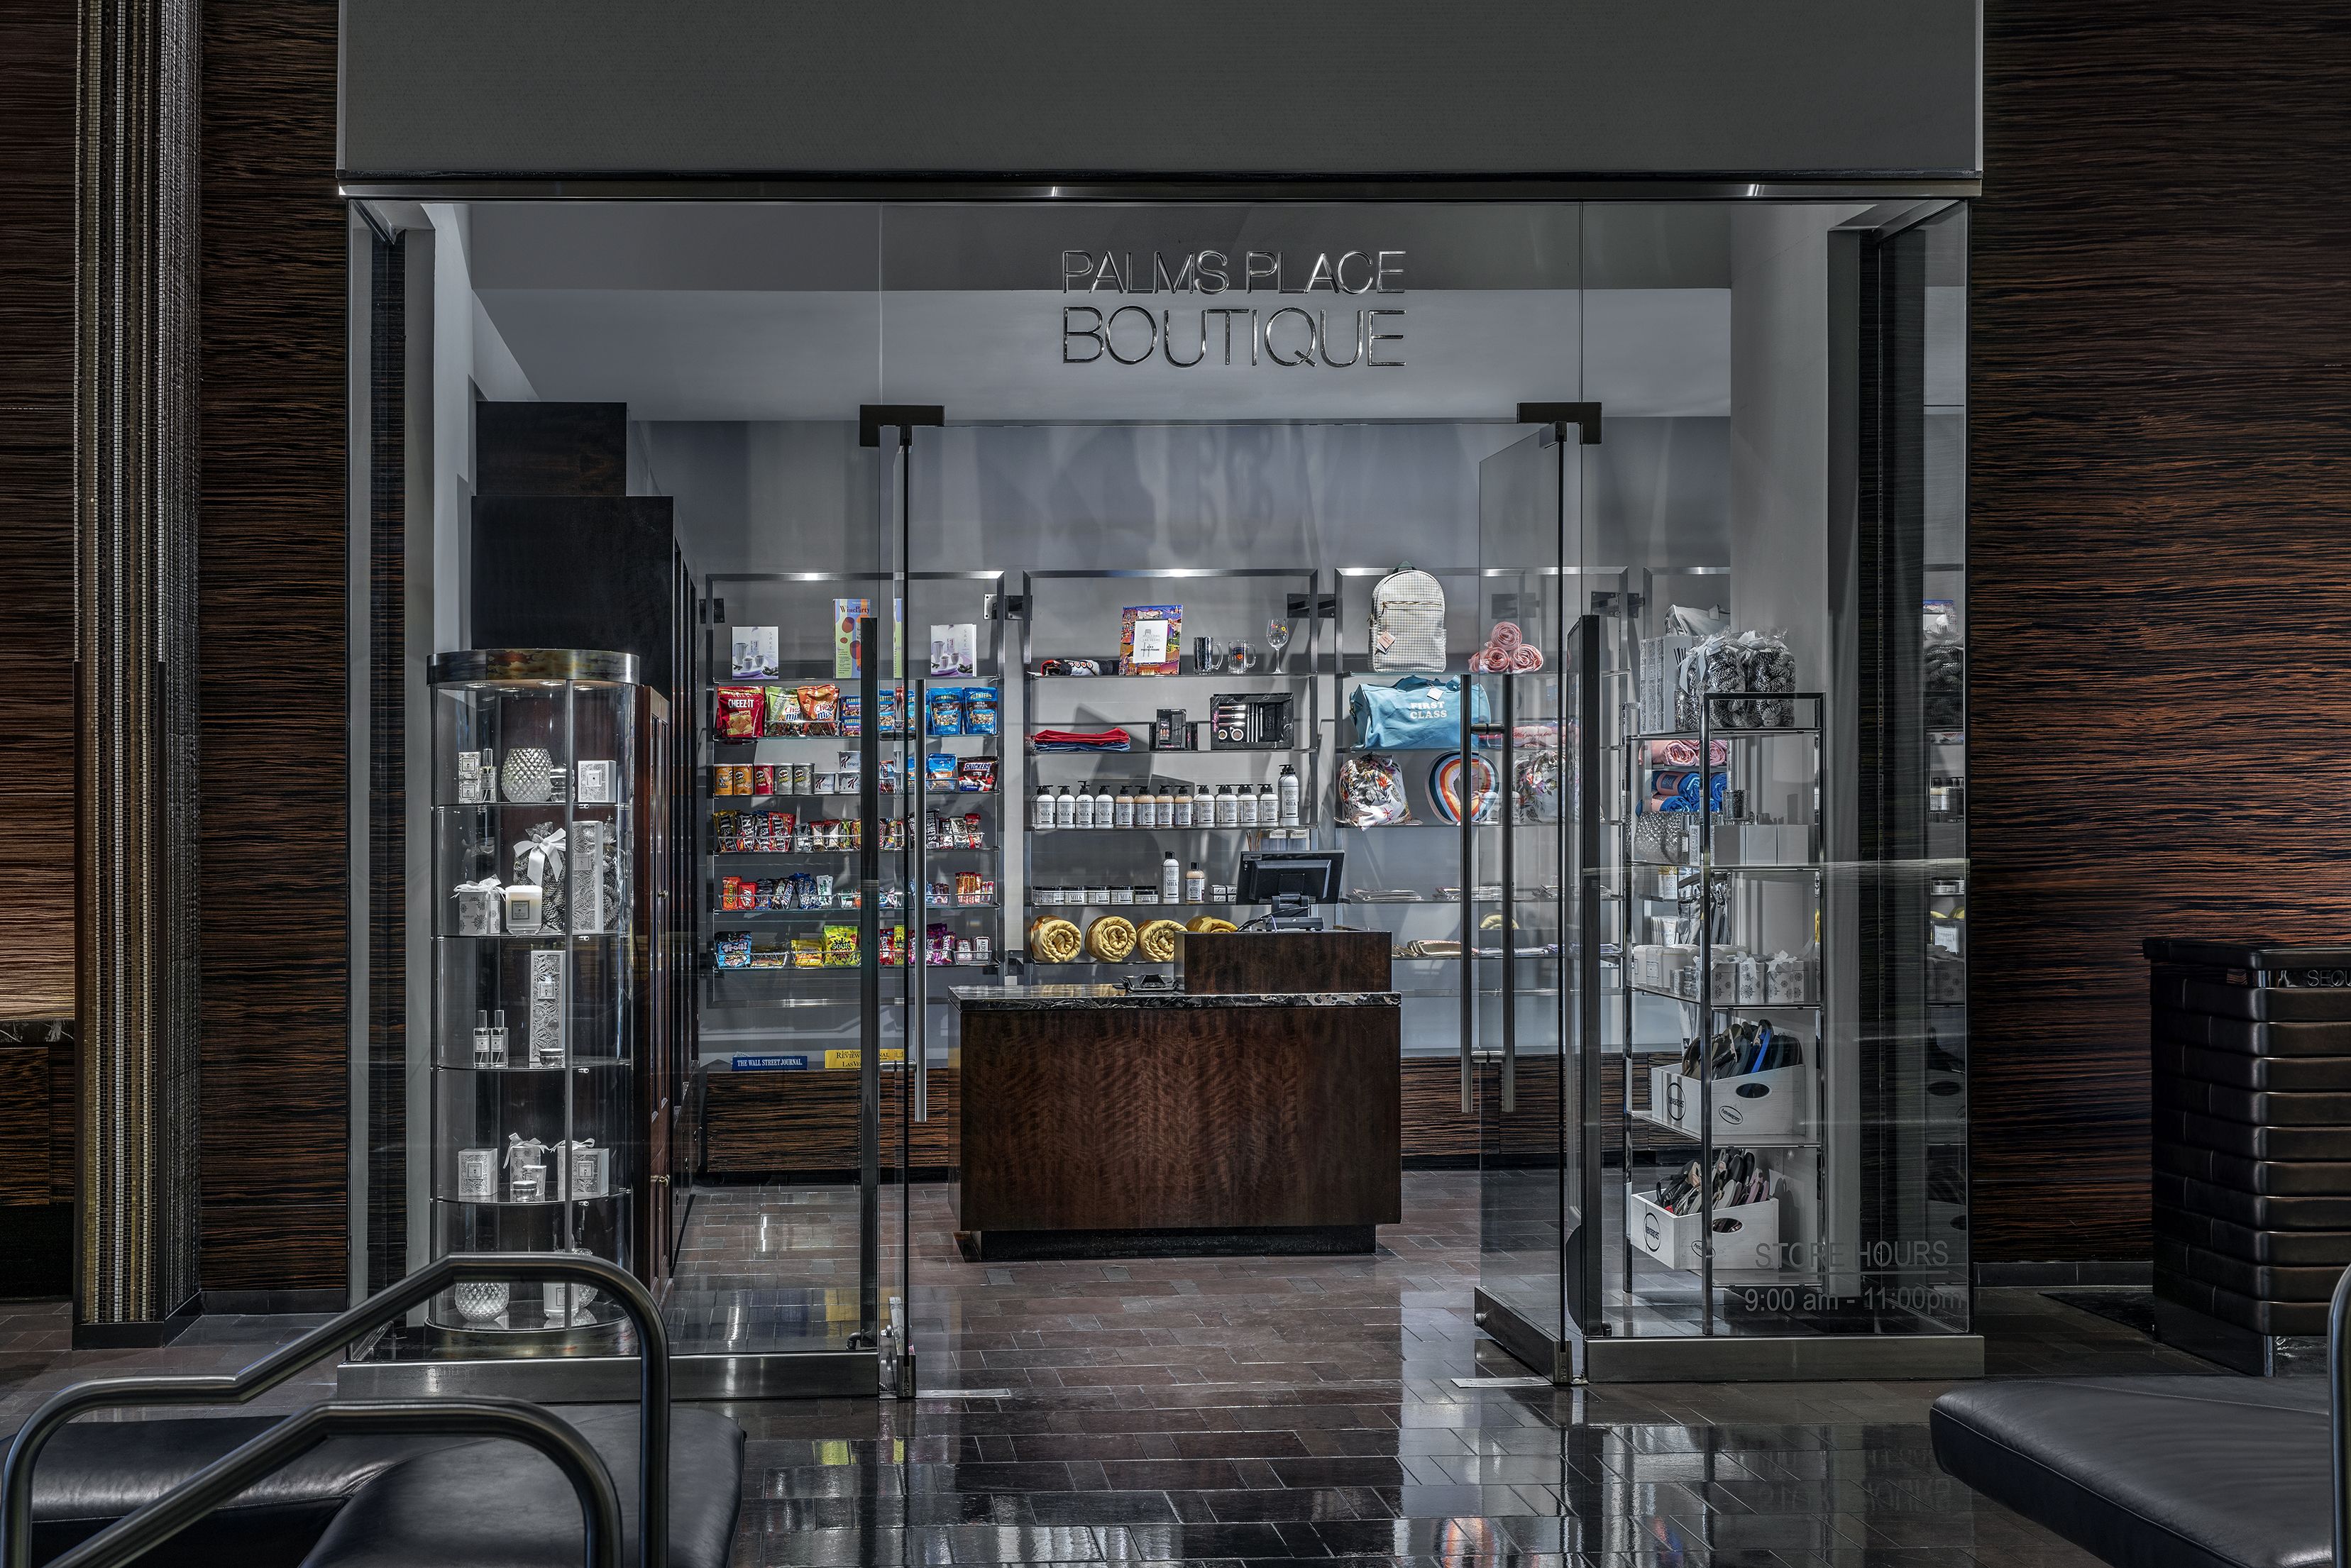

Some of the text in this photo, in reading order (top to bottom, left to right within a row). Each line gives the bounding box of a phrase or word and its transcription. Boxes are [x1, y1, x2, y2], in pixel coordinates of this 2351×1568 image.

[1063, 250, 1406, 294] PALMS PLACE
[1063, 305, 1406, 368] BOUTIQUE
[1410, 710, 1448, 719] CLASS
[841, 756, 851, 768] K
[815, 776, 822, 789] K
[848, 777, 858, 790] K
[722, 942, 747, 952] Trolli
[1755, 1240, 1949, 1269] STORE HOURS
[1744, 1288, 1795, 1311] 9:00
[1802, 1293, 1839, 1311] am
[1863, 1286, 1963, 1315] 11:00pm
